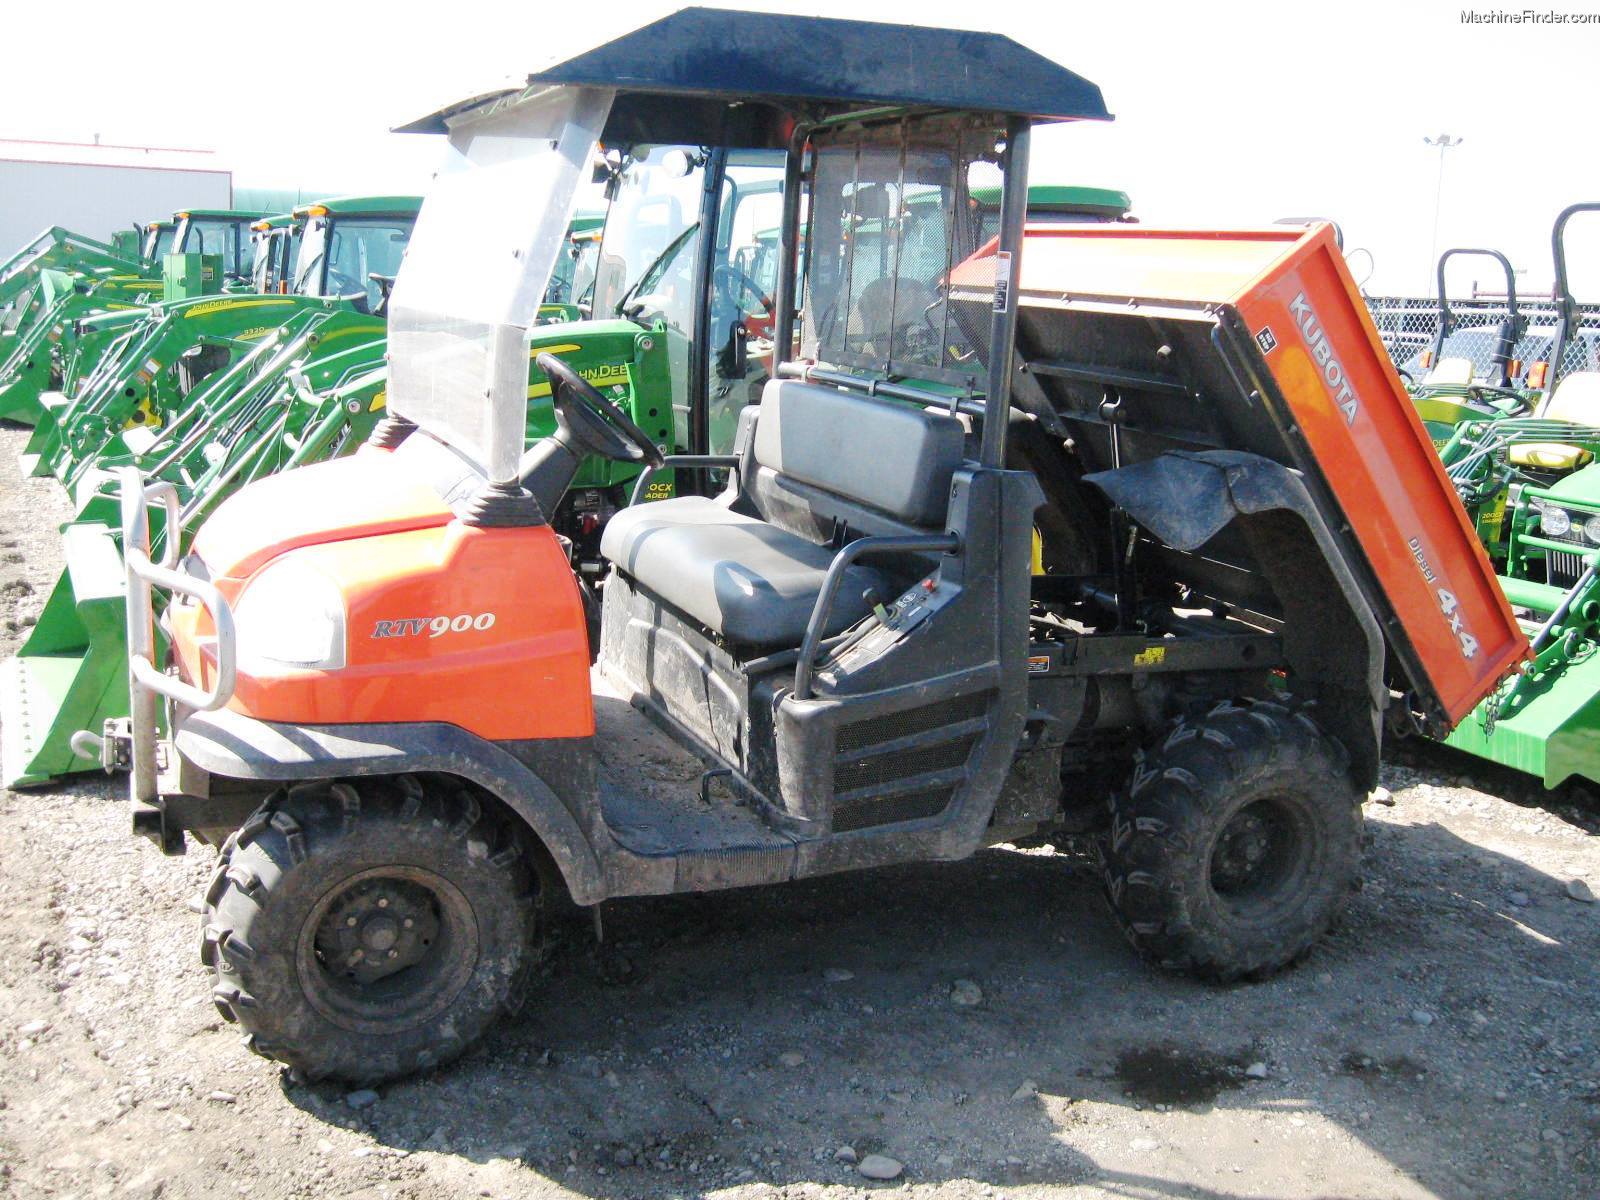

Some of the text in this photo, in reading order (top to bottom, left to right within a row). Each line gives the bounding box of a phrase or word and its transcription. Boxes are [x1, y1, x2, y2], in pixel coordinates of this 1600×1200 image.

[1258, 334, 1270, 350] STEP
[1288, 292, 1359, 426] KUBOTA
[599, 364, 628, 378] DEE
[1408, 536, 1437, 585] Diesel
[371, 612, 497, 639] RTV900
[1437, 587, 1478, 658] 4x4
